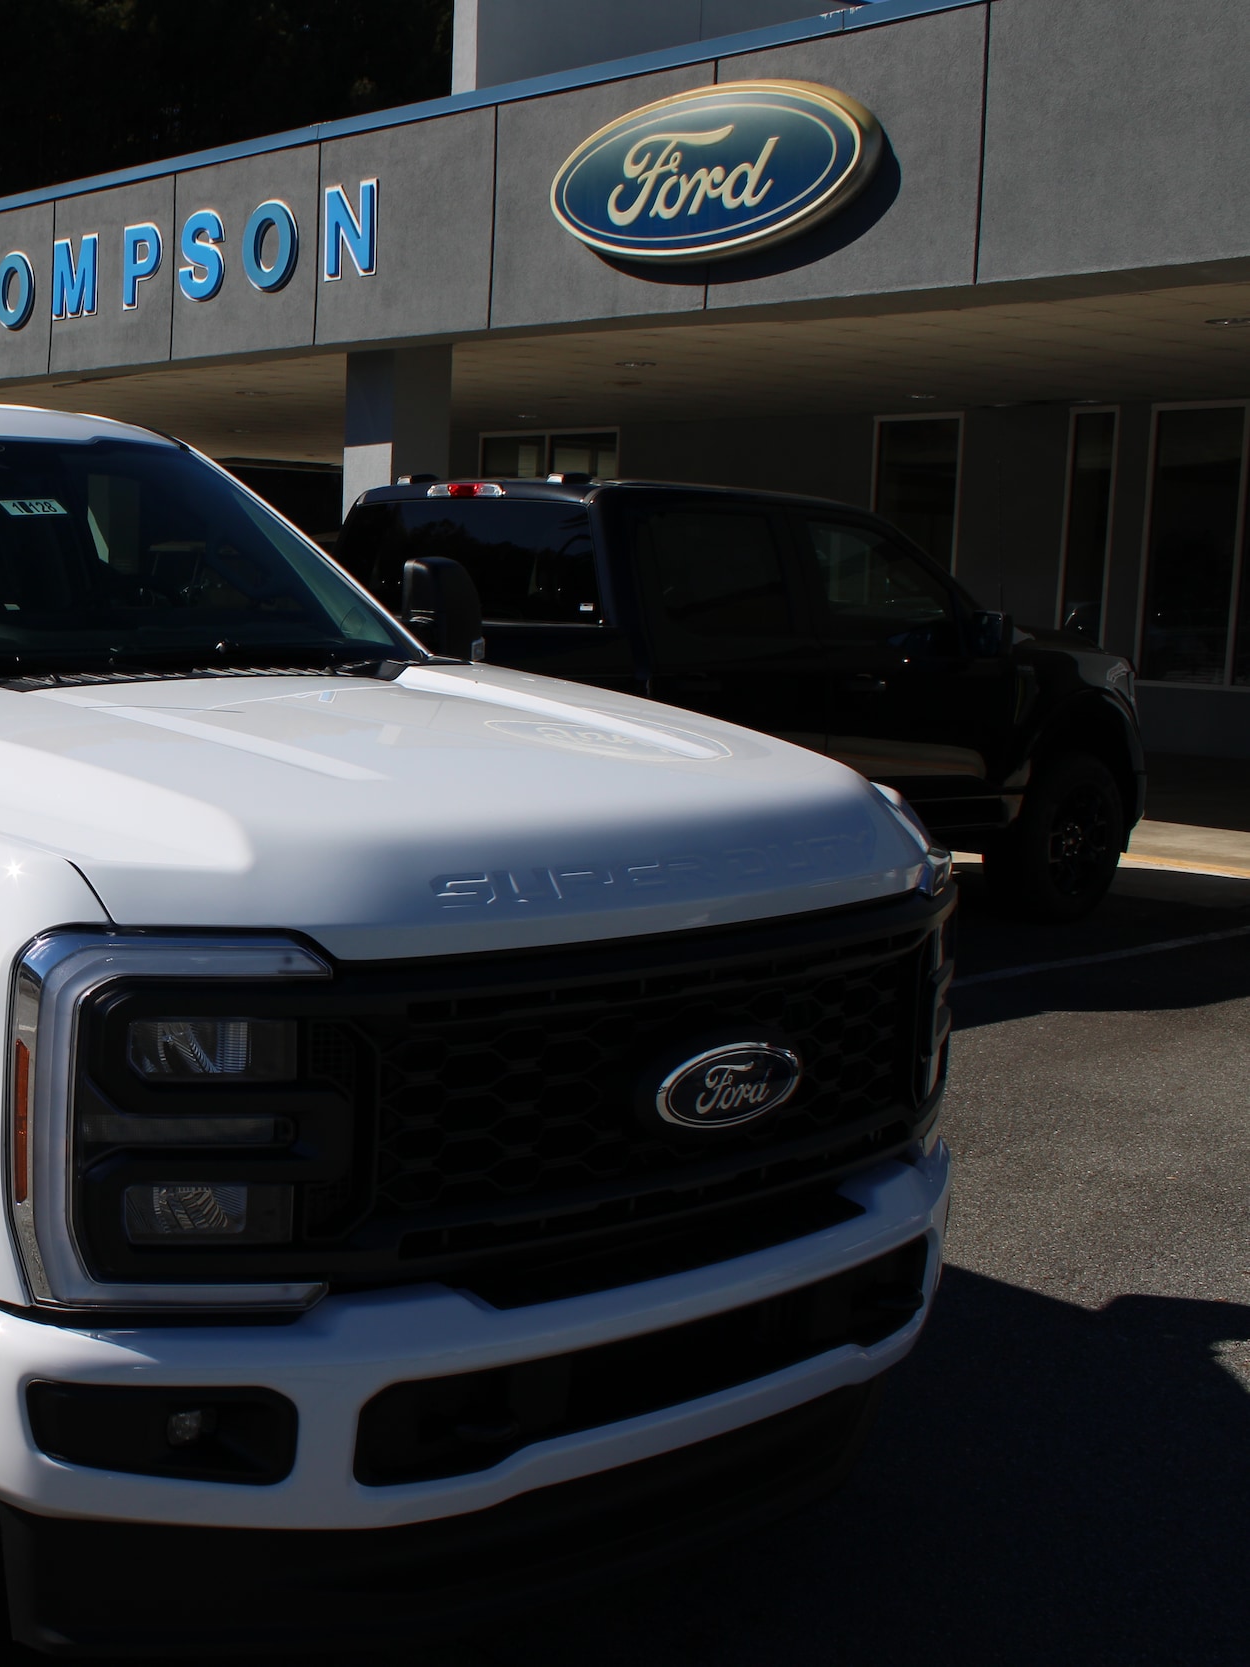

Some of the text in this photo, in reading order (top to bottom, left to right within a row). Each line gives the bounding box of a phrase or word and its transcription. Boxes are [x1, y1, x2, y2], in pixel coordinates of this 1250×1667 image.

[607, 124, 780, 226] Ford
[429, 856, 717, 910] SUPER
[696, 1061, 772, 1114] Ford
